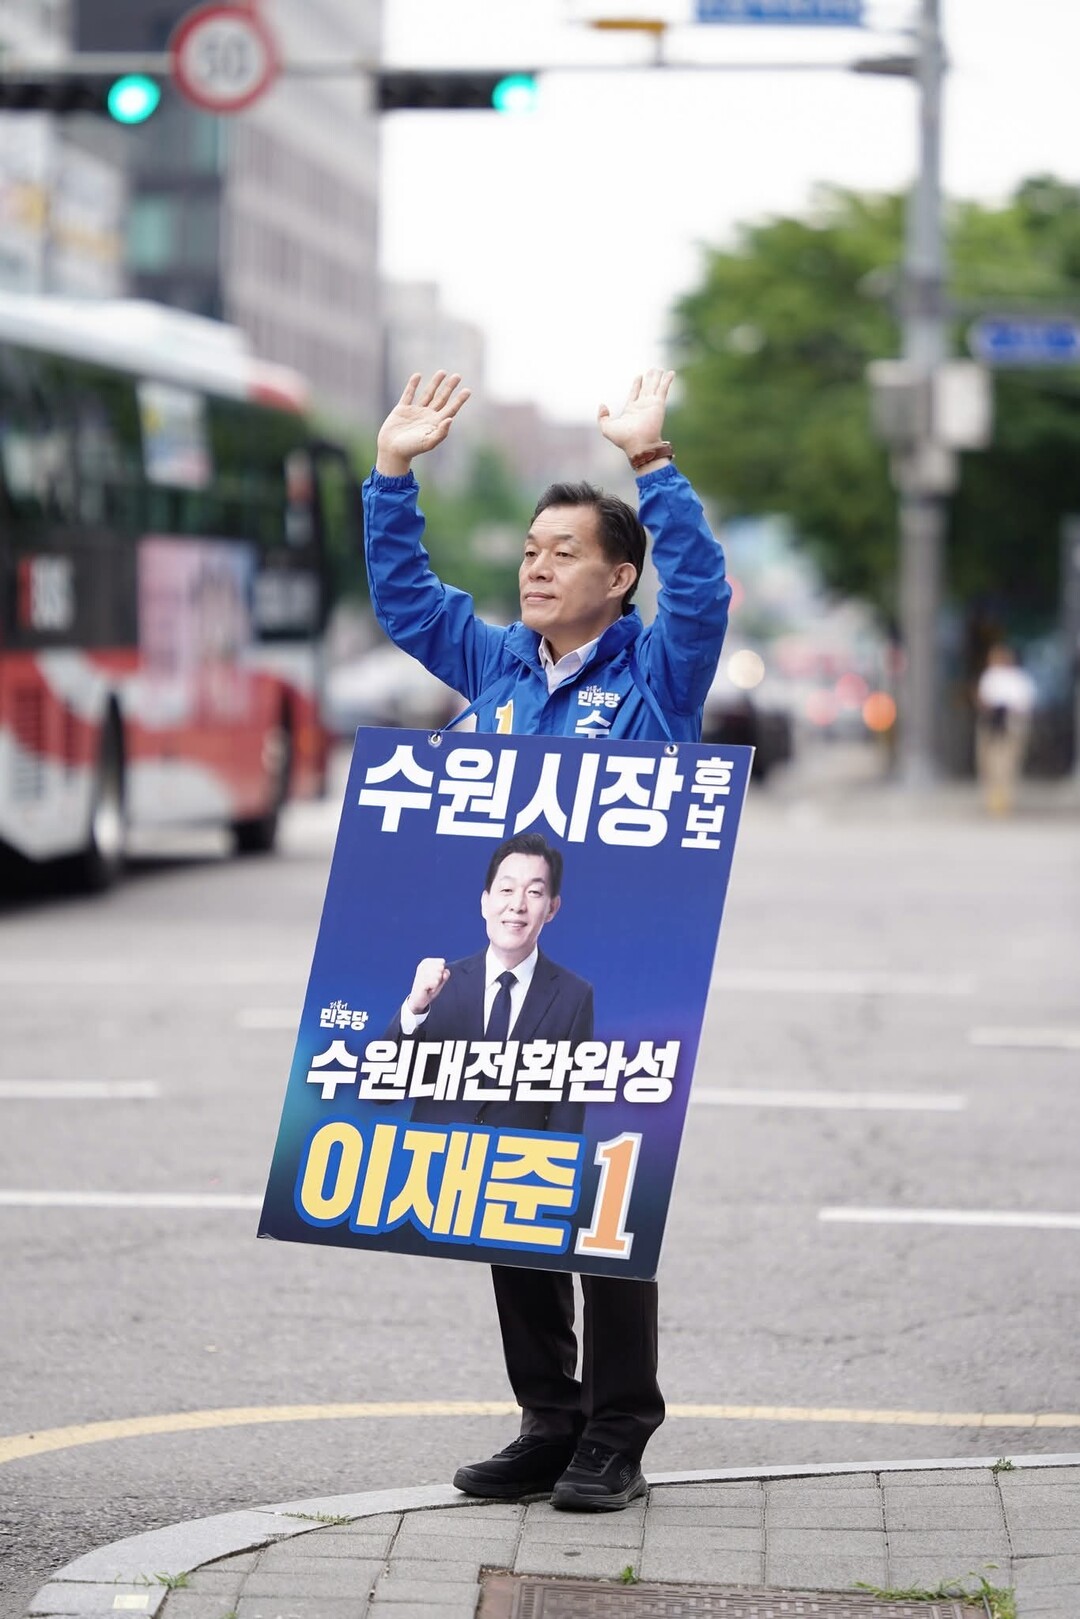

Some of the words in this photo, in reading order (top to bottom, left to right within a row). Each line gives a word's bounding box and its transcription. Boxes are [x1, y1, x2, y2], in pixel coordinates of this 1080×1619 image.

[494, 699, 514, 735] 1
[578, 690, 620, 708] 민주당
[575, 709, 611, 739] 수
[358, 744, 684, 848] 수원시장
[680, 756, 734, 850] 후보
[320, 1008, 369, 1031] 민주당
[306, 1039, 681, 1104] 수원대전환완성
[300, 1121, 581, 1247] 이재준
[574, 1131, 642, 1260] 1
